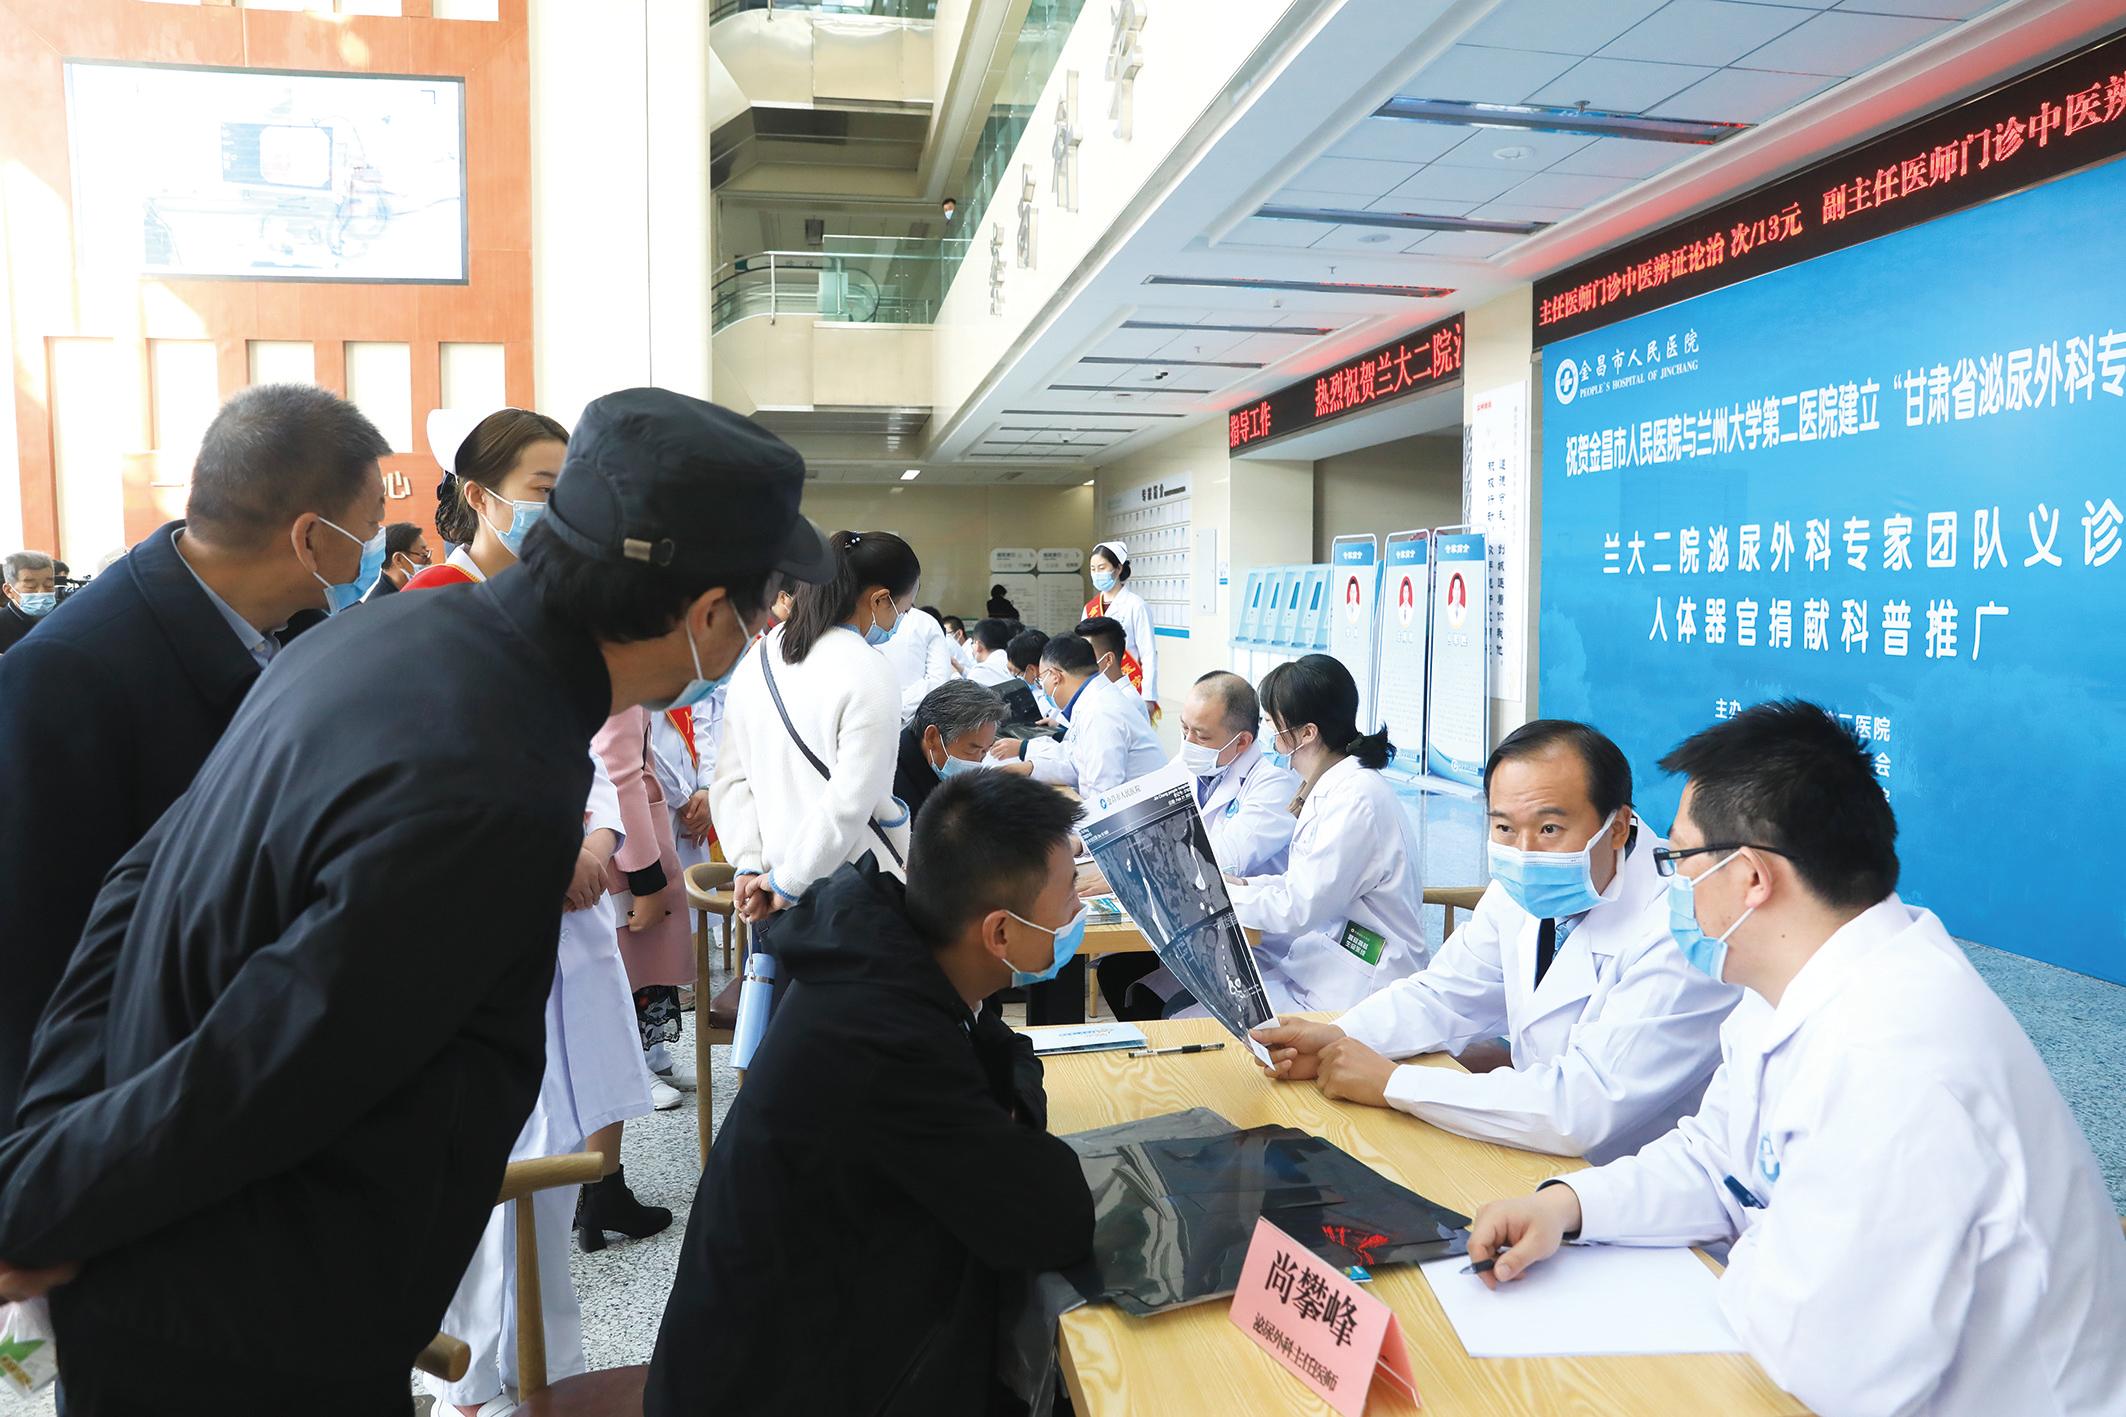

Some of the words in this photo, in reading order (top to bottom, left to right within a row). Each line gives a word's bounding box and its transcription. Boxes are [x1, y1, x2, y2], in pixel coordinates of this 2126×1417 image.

[1539, 231, 1725, 327] 主任医师门诊中医辨证论治
[1730, 201, 1803, 258] 次/13元
[1579, 328, 1699, 382] 金昌市人民医院
[1612, 373, 1646, 390] HOSPITAL
[1647, 369, 1658, 382] OF
[1660, 359, 1699, 379] JINCHANG
[1229, 400, 1272, 448] 指导工作
[382, 470, 411, 499] 心
[1603, 497, 2125, 575] 兰大二院泌尿外科专家团队义诊
[1648, 596, 2010, 661] 人体器官捐献科普推广
[1264, 1249, 1358, 1347] 尚攀峰
[1252, 1312, 1339, 1391] 泌尿外科主任医师
